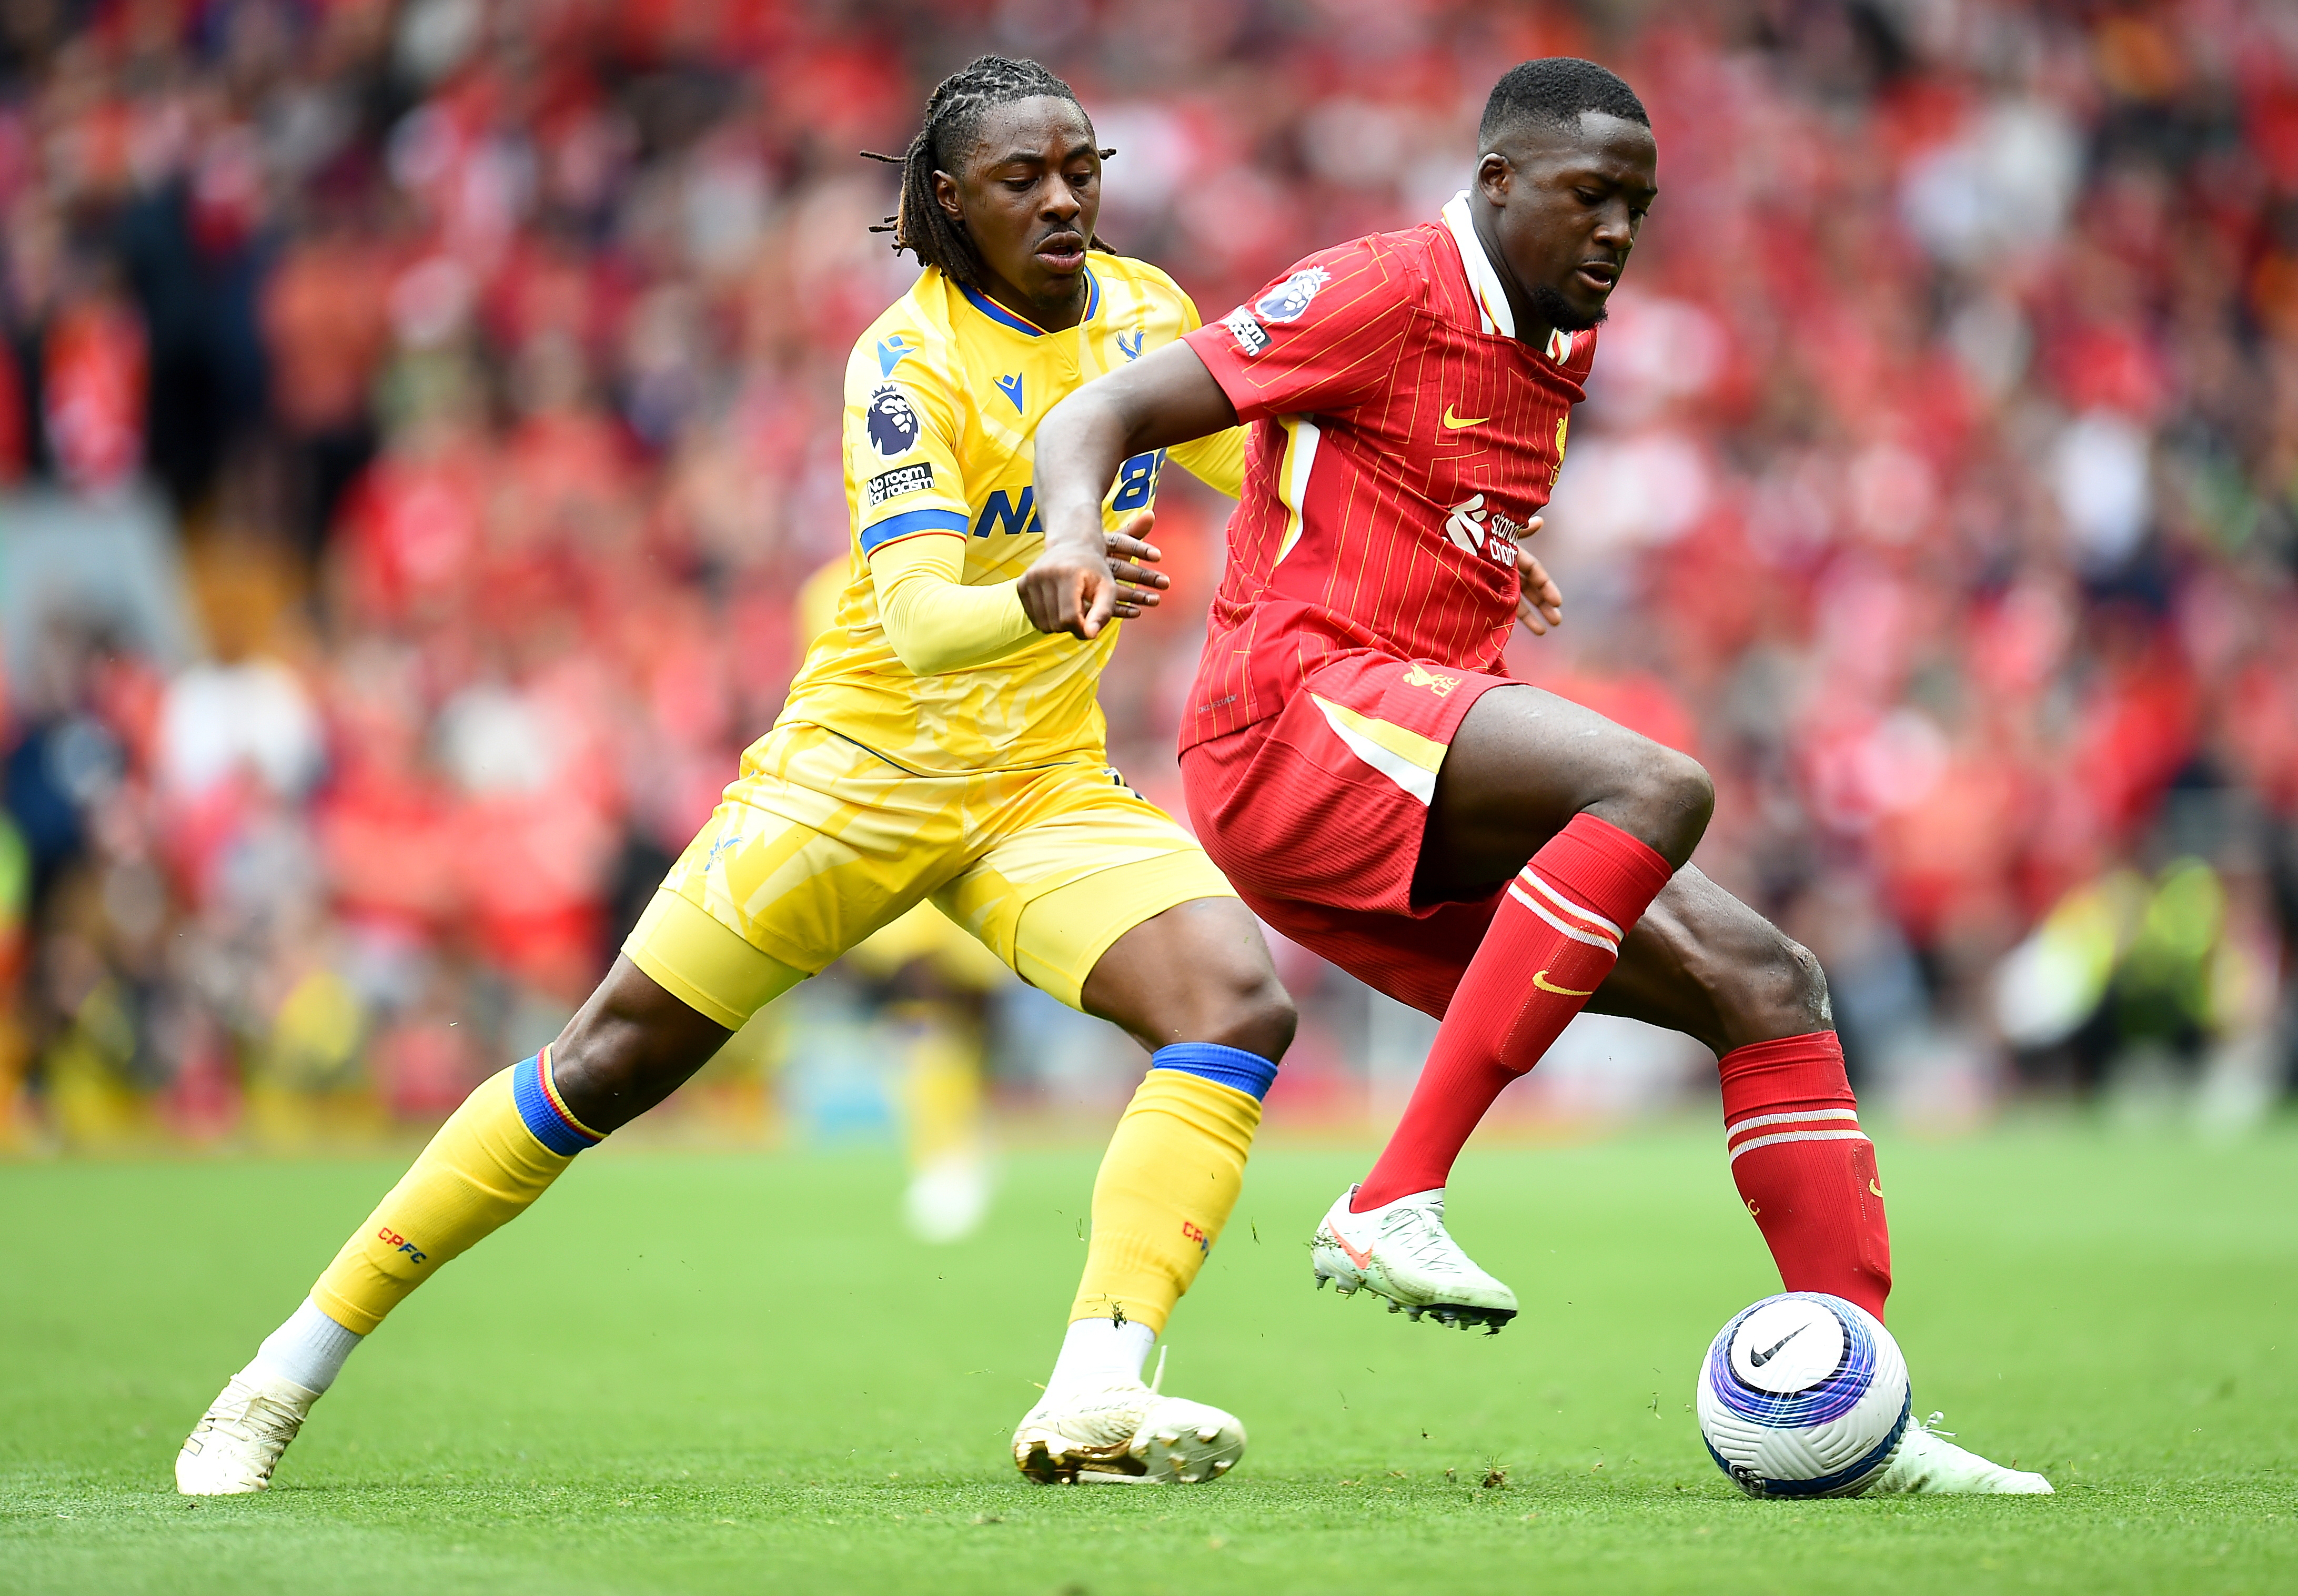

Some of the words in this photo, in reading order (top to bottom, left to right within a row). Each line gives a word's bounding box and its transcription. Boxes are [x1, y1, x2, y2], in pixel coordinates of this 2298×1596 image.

[867, 478, 884, 492] No
[884, 466, 925, 486] room
[868, 489, 885, 507] for
[886, 477, 935, 498] racism
[378, 1227, 427, 1264] CPFC
